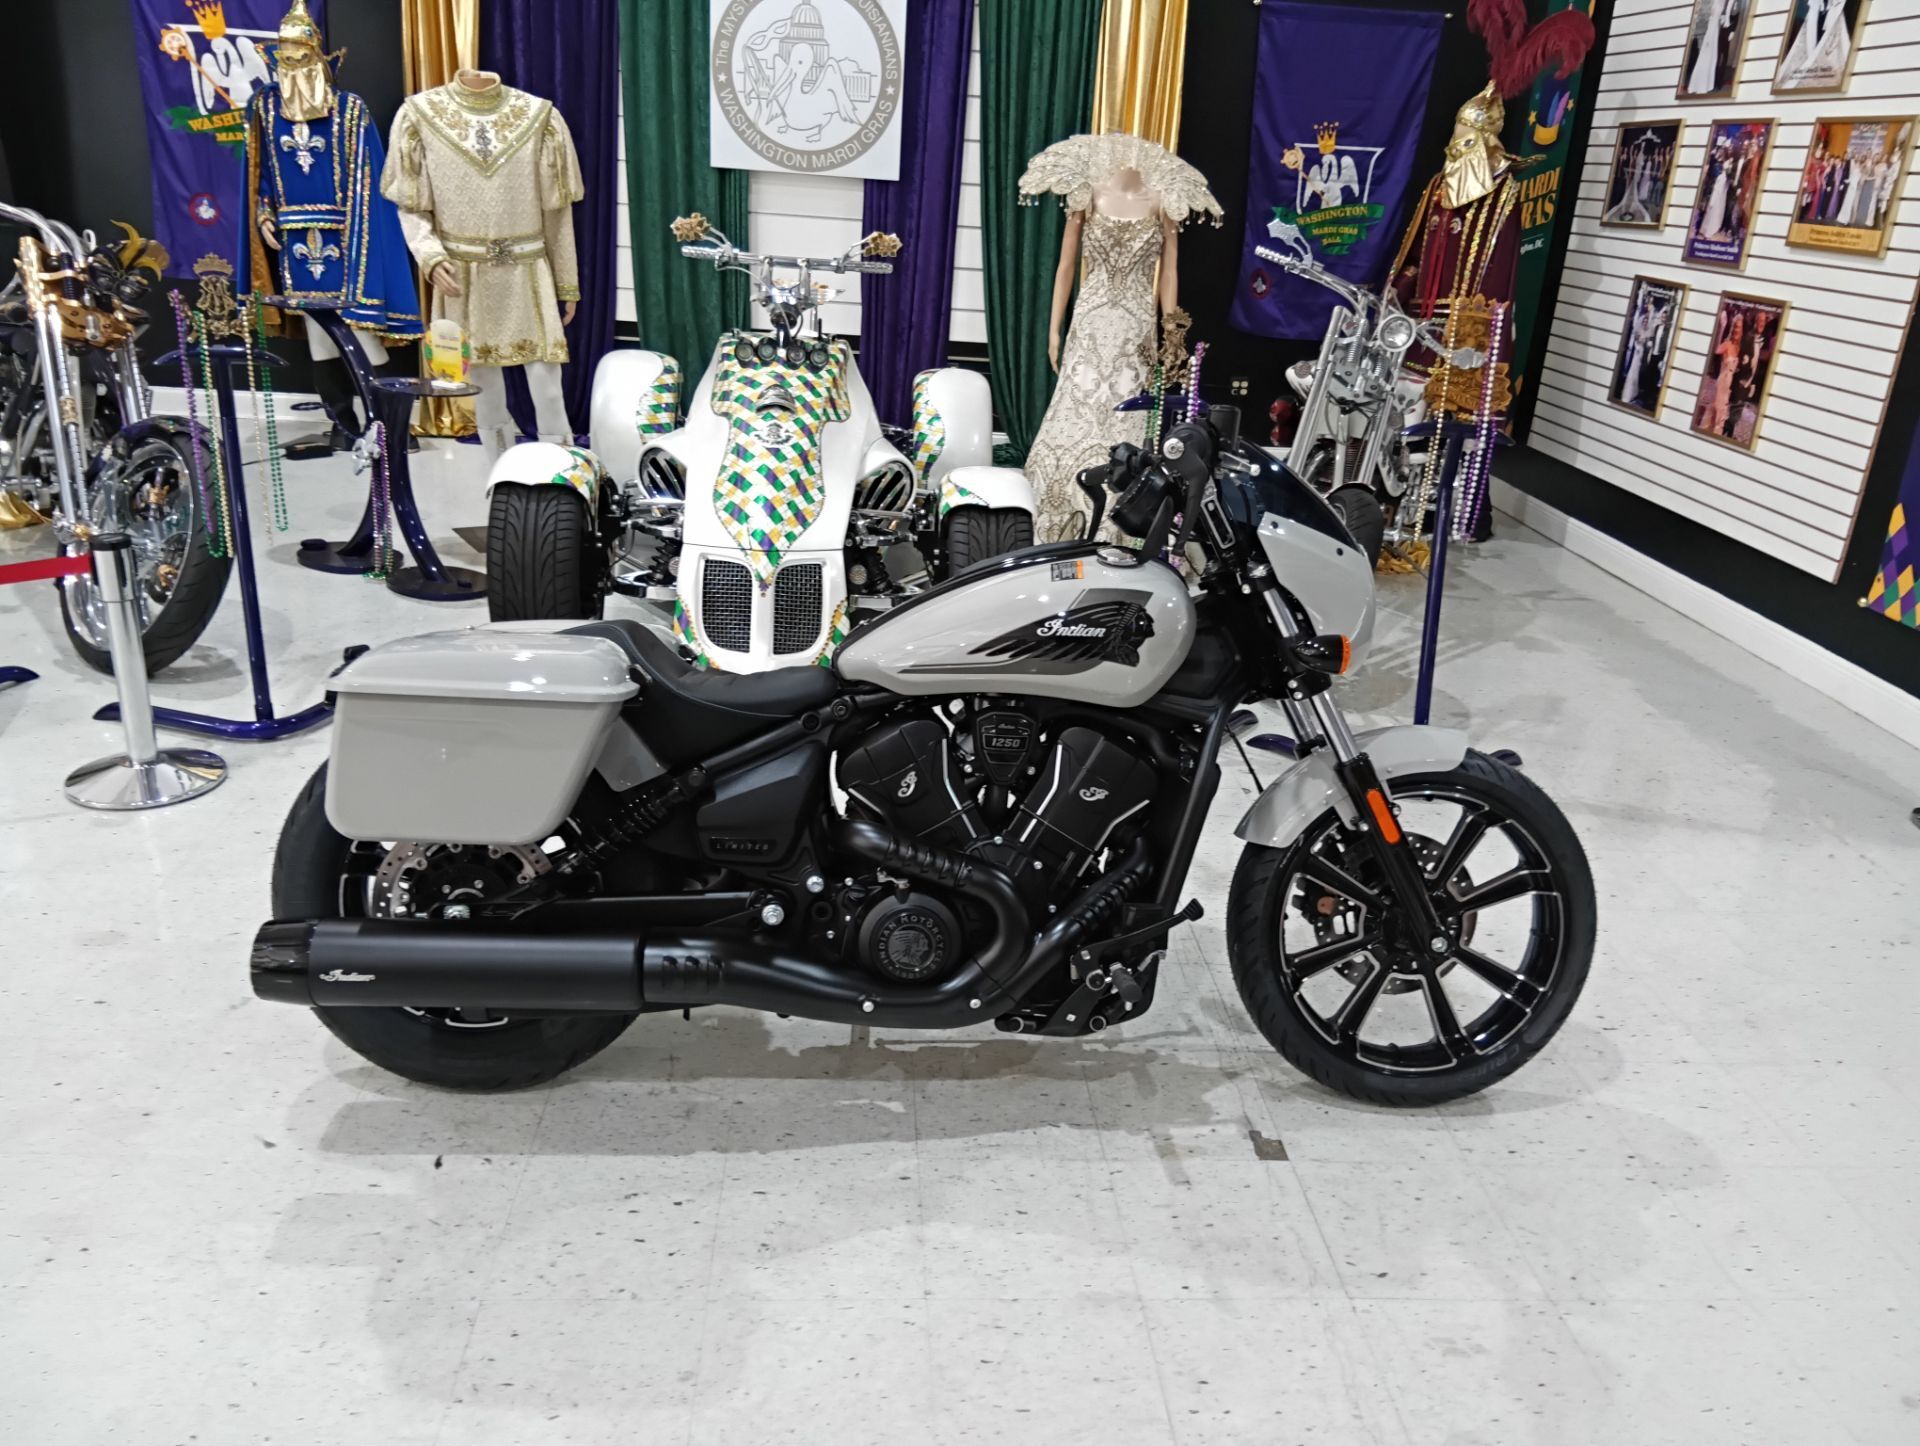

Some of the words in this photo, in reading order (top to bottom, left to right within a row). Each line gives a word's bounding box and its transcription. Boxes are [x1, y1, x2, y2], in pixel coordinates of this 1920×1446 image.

[716, 40, 730, 67] The
[188, 111, 243, 131] WASHI
[719, 87, 807, 168] WASHINGTON
[812, 143, 862, 169] MARDI
[861, 99, 893, 143] GRAS
[1296, 206, 1368, 225] WASHINGTON
[1520, 193, 1556, 229] RAS
[1036, 619, 1107, 638] Indian
[991, 737, 1020, 747] 1250
